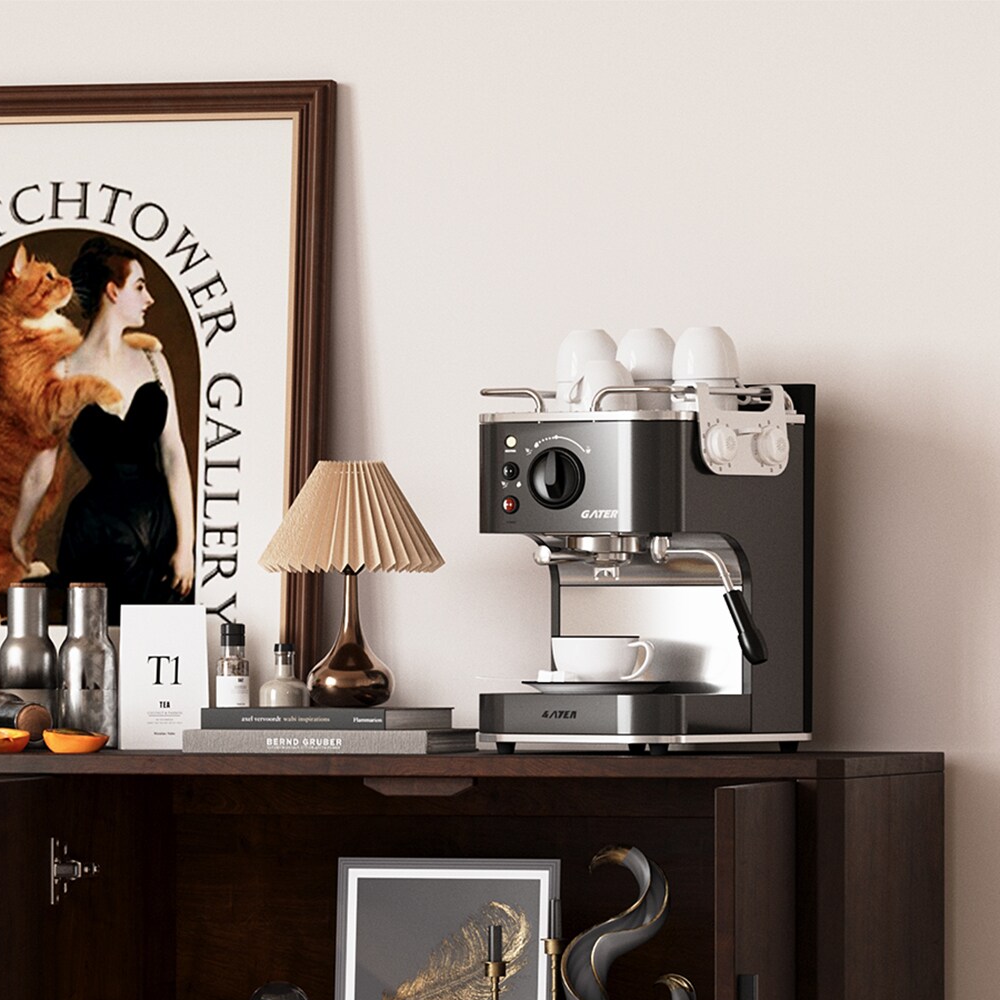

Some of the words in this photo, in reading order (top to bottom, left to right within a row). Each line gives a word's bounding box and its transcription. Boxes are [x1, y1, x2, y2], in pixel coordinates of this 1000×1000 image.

[200, 372, 243, 624] GALLERY
[146, 655, 183, 686] T1
[159, 700, 171, 709] TEA
[266, 737, 299, 747] BERND
[302, 738, 343, 747] GRUBER
